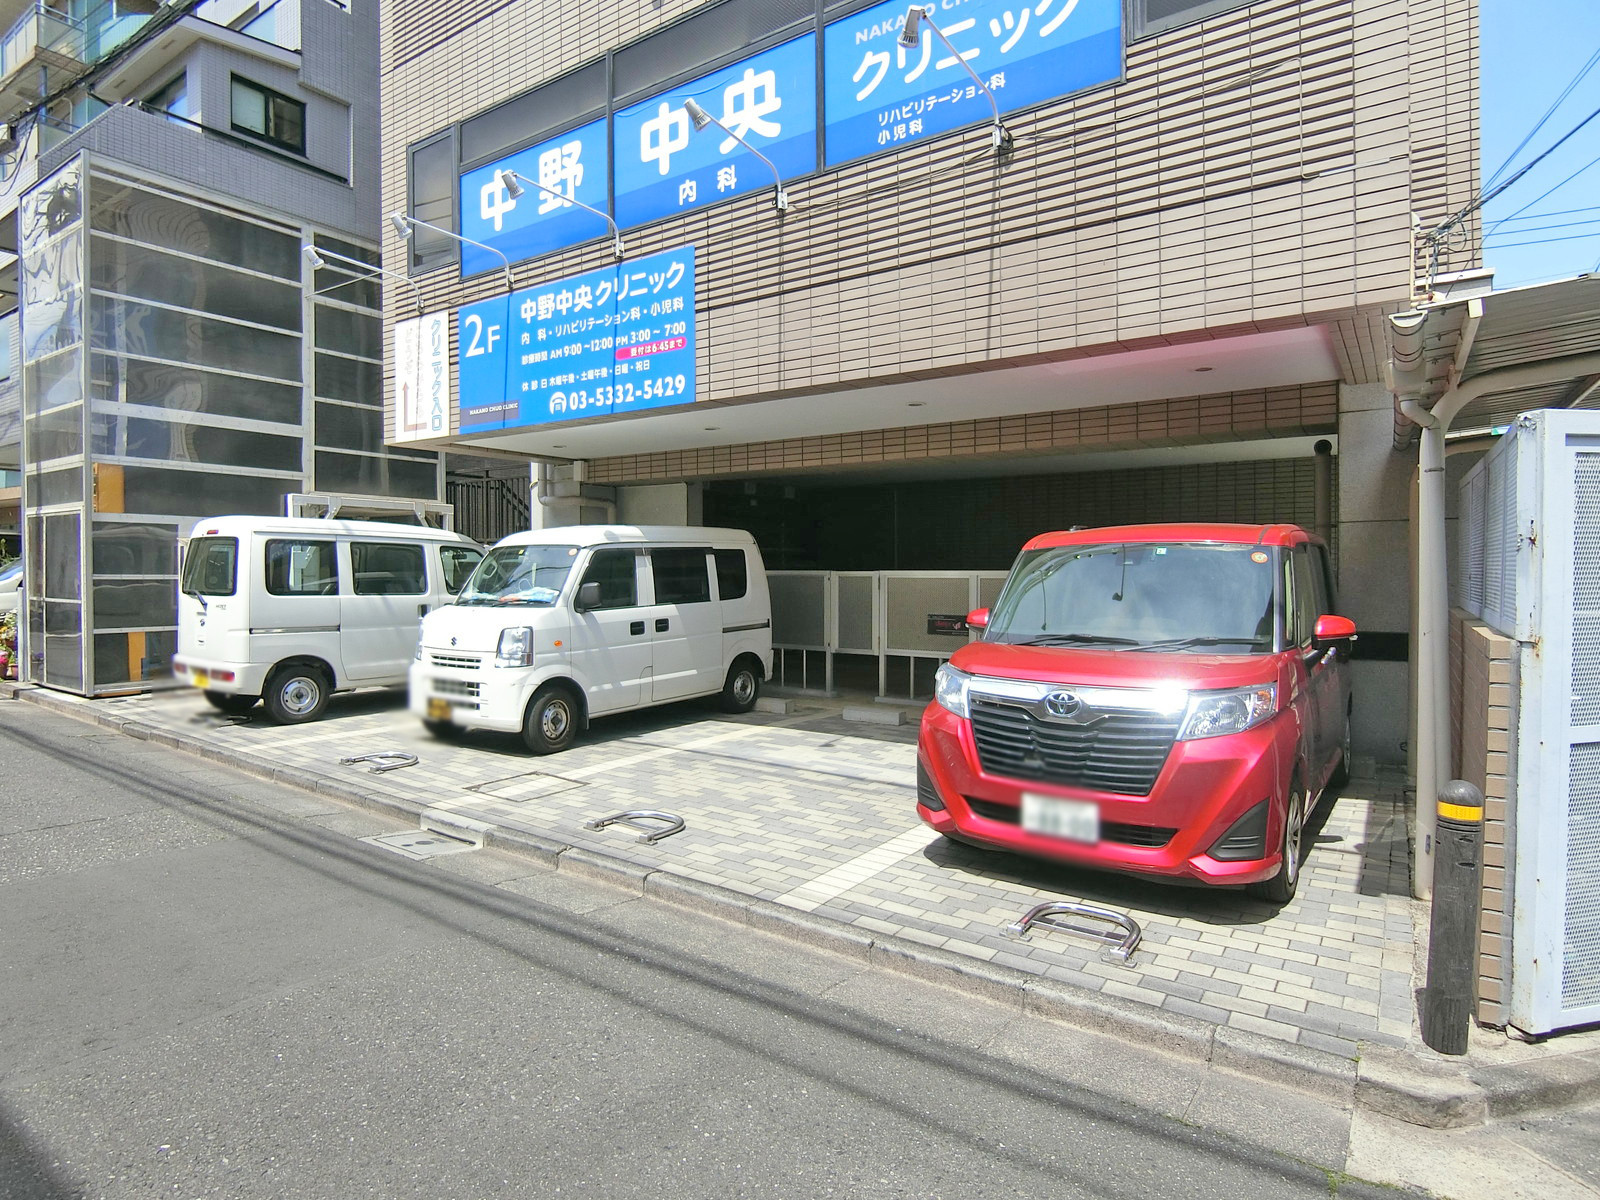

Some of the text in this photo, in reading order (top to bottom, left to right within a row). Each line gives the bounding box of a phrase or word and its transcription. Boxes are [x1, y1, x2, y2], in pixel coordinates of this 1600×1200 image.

[855, 2, 936, 45] NAKAO
[480, 0, 1080, 232] 中野 中央 クリニック
[878, 72, 1006, 127] リハビリテーション科
[877, 118, 924, 145] 小児科
[520, 261, 685, 324] 中野中央クリニック
[465, 314, 500, 358] 2F
[550, 348, 563, 360] AM
[563, 343, 582, 357] 9:00
[615, 335, 629, 347] PM
[630, 328, 651, 344] 3:00
[664, 321, 686, 337] 7:00
[431, 319, 443, 432] クリニック入口
[569, 374, 686, 411] 03-5332-5429
[469, 407, 488, 415] NAKANO
[502, 402, 518, 410] CLINIC
